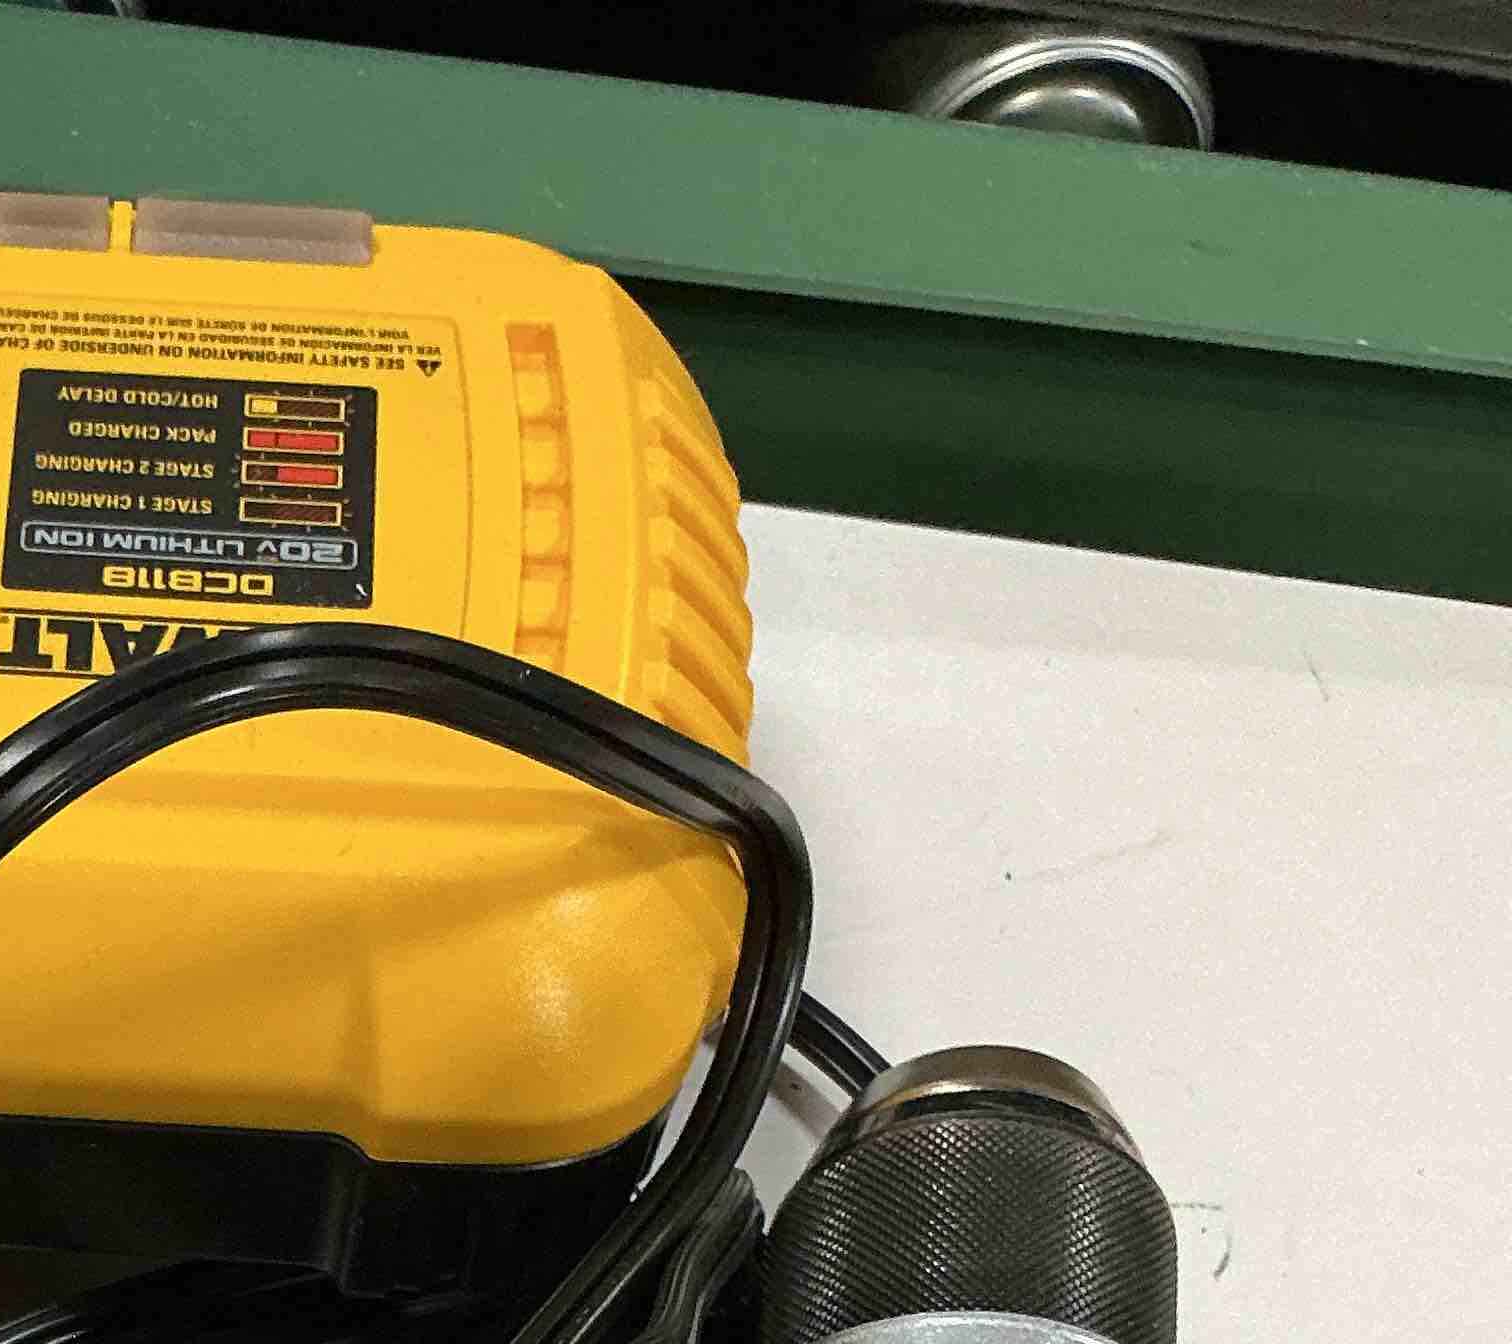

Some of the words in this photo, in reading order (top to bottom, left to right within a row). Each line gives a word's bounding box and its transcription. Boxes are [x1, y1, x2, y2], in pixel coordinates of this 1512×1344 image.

[35, 337, 56, 350] OF
[61, 339, 154, 356] UNDERSIDE
[158, 345, 184, 358] ON
[188, 347, 305, 366] INFORMATION
[309, 352, 370, 369] SAFETY
[375, 355, 405, 370] SEE
[56, 385, 120, 405] DELAY
[123, 387, 218, 409] HOT/COLD
[68, 420, 161, 441] CHARGED
[166, 425, 217, 444] PACK
[35, 453, 136, 474] CHARGING
[138, 460, 149, 475] 2
[153, 462, 215, 478] STAGE
[32, 488, 133, 511] CHARGING
[138, 495, 147, 511] 1
[151, 497, 213, 514] STAGE
[34, 527, 94, 547] ION
[102, 533, 246, 557] LITHIUM
[102, 565, 274, 597] DCB118
